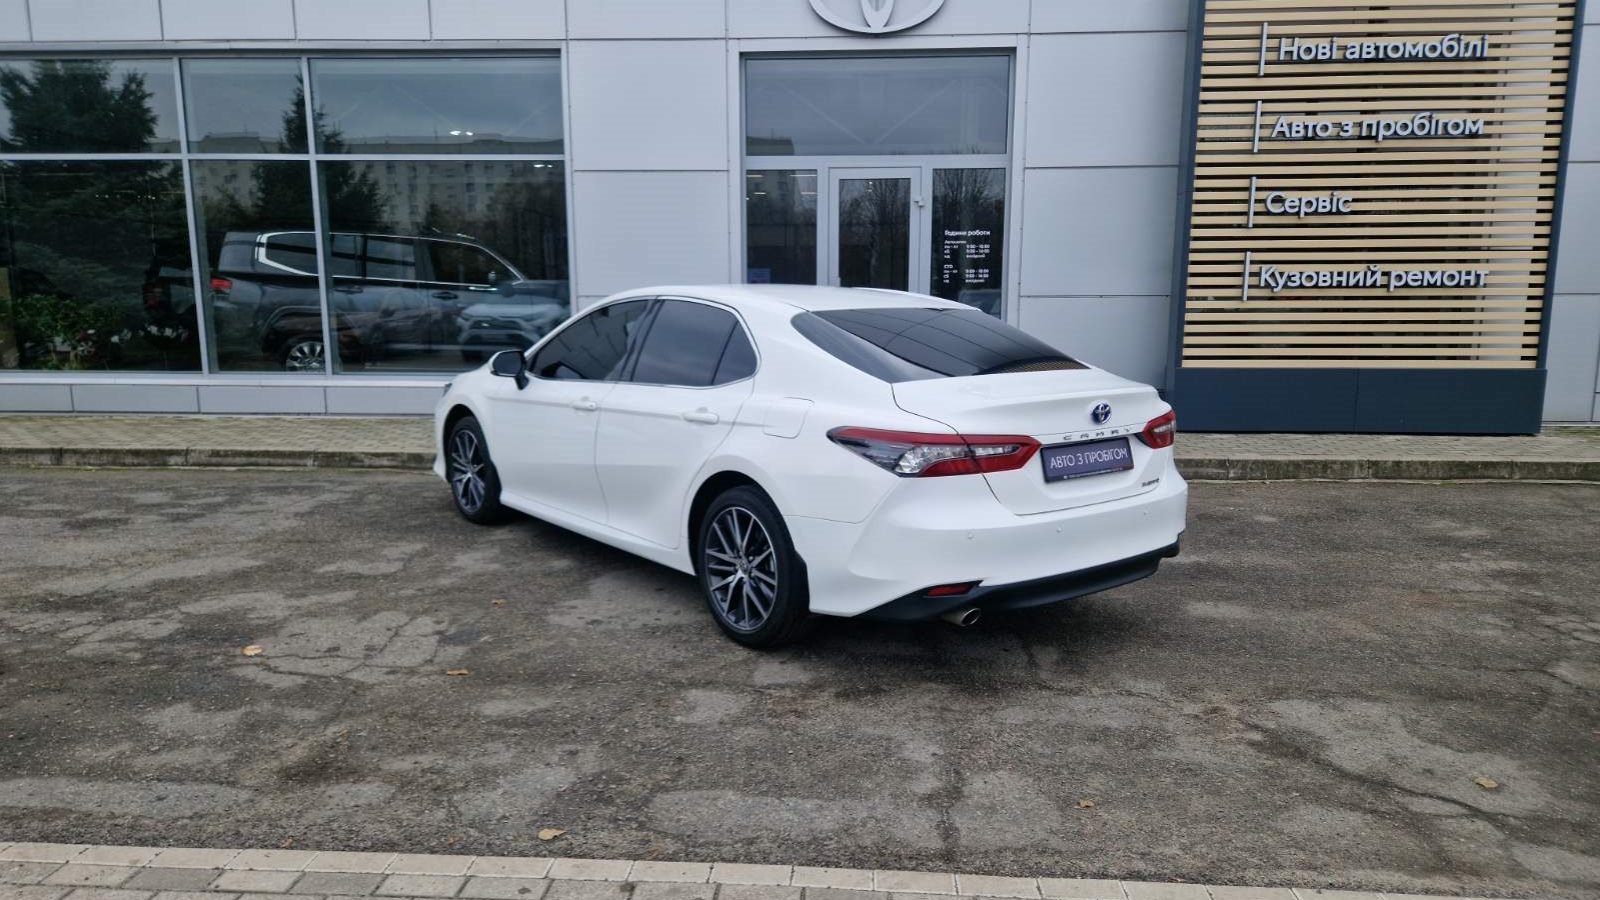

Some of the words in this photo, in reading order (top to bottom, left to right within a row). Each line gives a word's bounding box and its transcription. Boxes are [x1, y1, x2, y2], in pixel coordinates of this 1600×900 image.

[1279, 37, 1338, 61] Нові
[1345, 33, 1490, 60] автомобілі
[1271, 116, 1333, 139] Авто
[1340, 122, 1354, 138] з
[1361, 112, 1485, 142] пробігом
[1265, 191, 1353, 218] Сервіс
[1259, 264, 1382, 292] Кузовний
[1389, 270, 1489, 292] ремонт
[1050, 454, 1075, 469] АВТО
[1085, 448, 1128, 464] ПРОБІГОМ
